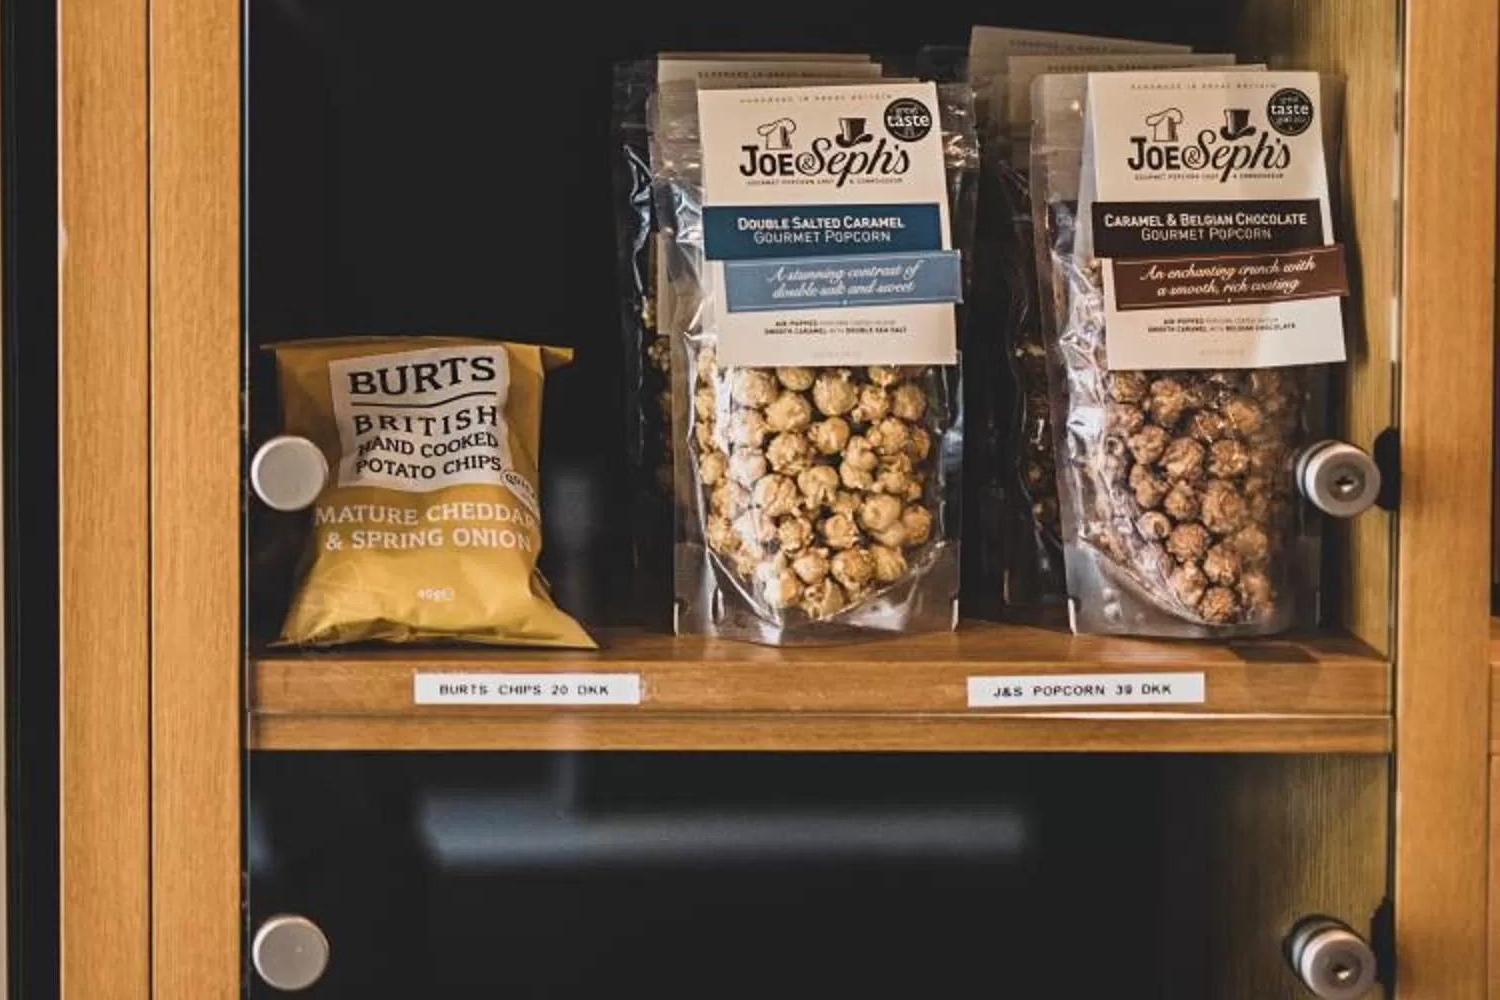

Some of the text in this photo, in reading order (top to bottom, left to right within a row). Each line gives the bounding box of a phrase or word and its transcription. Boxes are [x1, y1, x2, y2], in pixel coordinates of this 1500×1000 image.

[1271, 103, 1310, 116] taste
[887, 114, 930, 128] taste
[739, 144, 795, 177] JOE
[1127, 136, 1181, 171] JOE
[737, 215, 906, 231] DOUBLE SALTED CARAMEL
[1104, 212, 1308, 227] CARAMEL & BELGIAN CHOCOLATE
[754, 230, 891, 244] GOURMET POPCORN
[1141, 227, 1272, 241] GOURMET POPCORN
[787, 268, 845, 285] stunning
[1167, 263, 1237, 280] enchanting
[1238, 258, 1281, 275] crunch
[1283, 256, 1316, 273] with
[848, 280, 876, 295] and
[1223, 280, 1247, 293] rich
[1251, 278, 1300, 295] coating
[347, 356, 496, 395] BURTS
[352, 405, 498, 436] BRITISH
[358, 431, 499, 458] HAND COOKED
[356, 455, 502, 479] POTATO CHIPS
[315, 502, 535, 529] MATURE CHEDDAR
[325, 527, 532, 552] & SPRING ONION
[439, 684, 609, 695] BURTS CHIPS 20 DKK
[993, 686, 1023, 698] J&S
[1033, 684, 1106, 697] POPCORN
[1141, 682, 1172, 695] DKK
